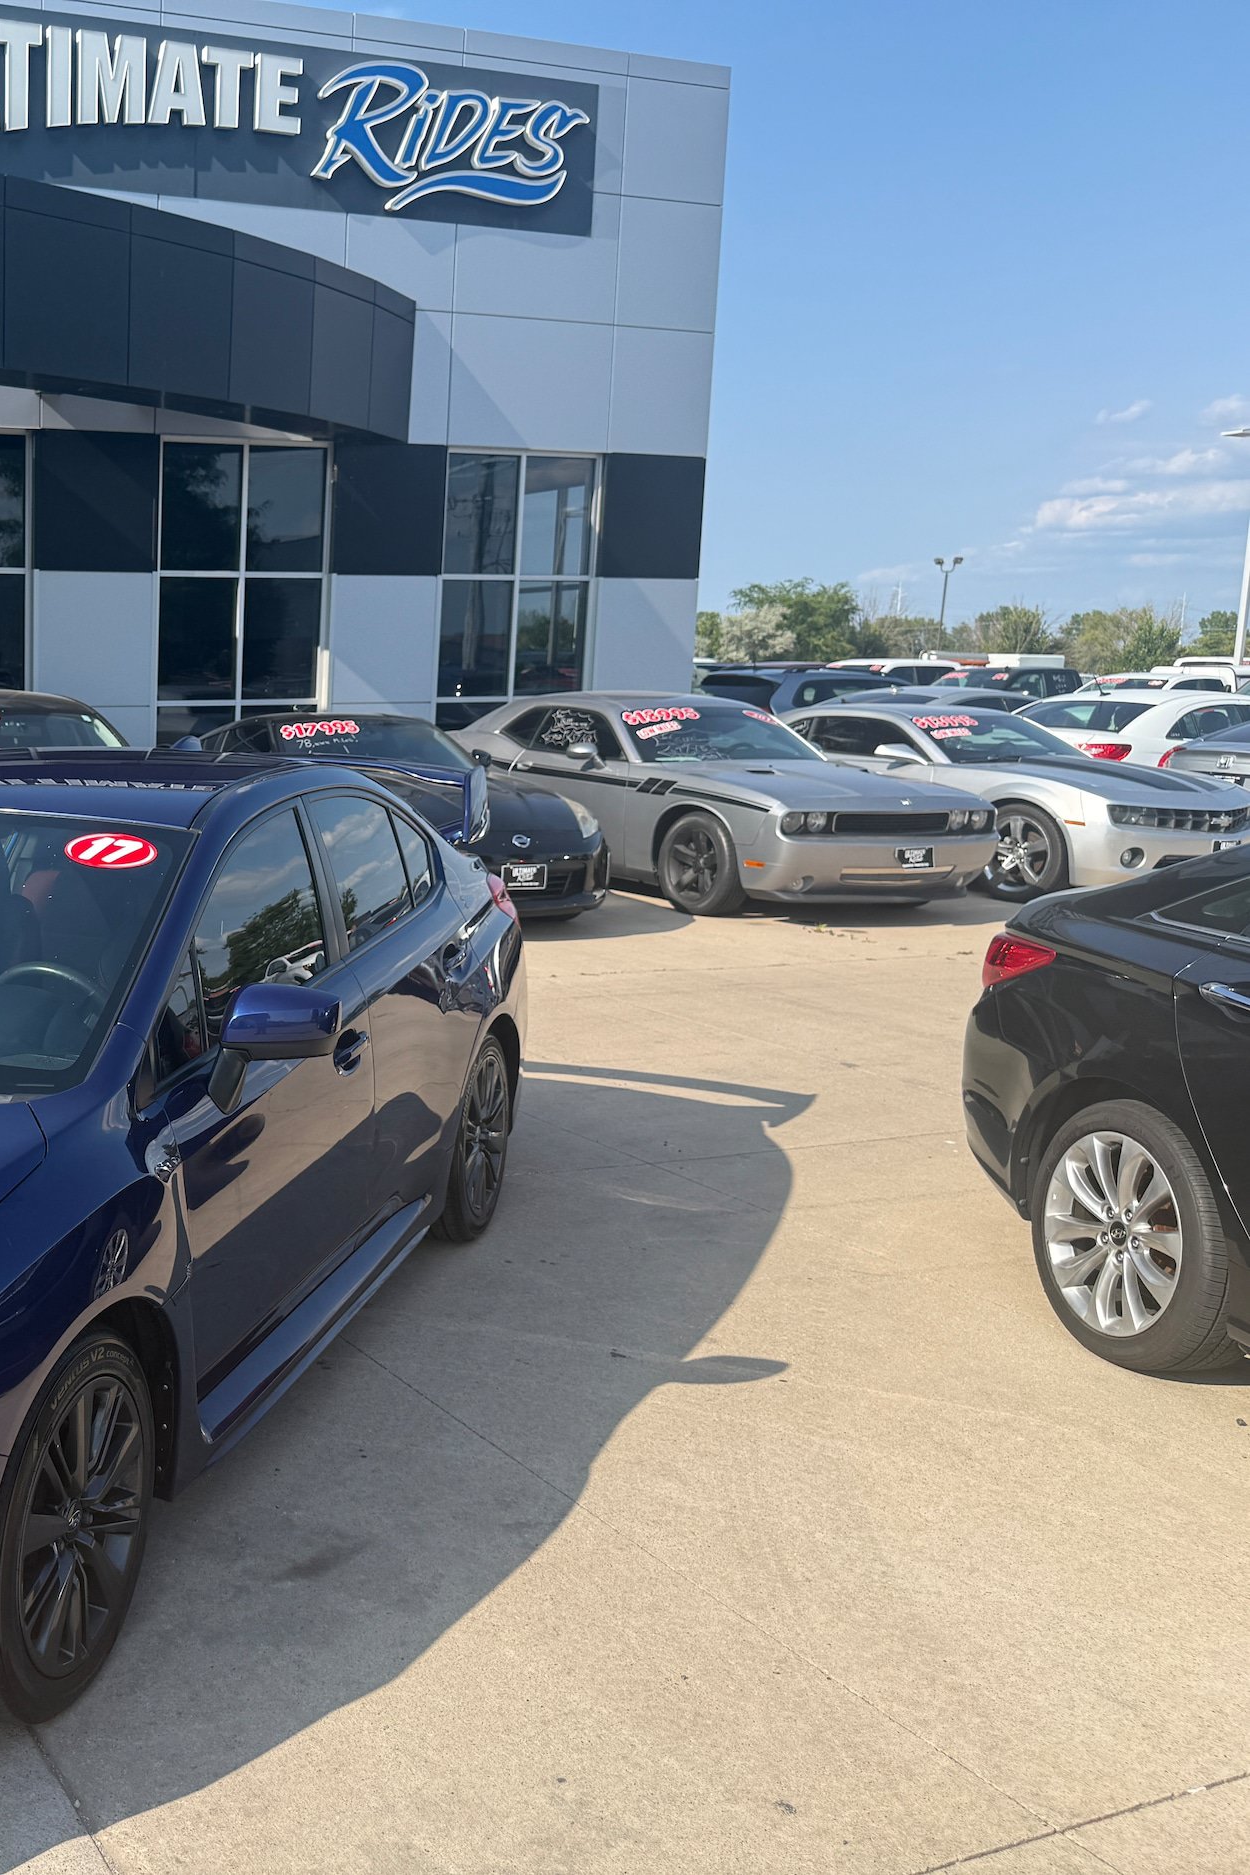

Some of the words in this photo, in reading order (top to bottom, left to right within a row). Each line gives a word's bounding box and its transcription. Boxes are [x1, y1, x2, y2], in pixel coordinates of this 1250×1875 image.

[280, 720, 360, 740] $17995
[78, 836, 144, 863] 17
[90, 1346, 105, 1362] V2
